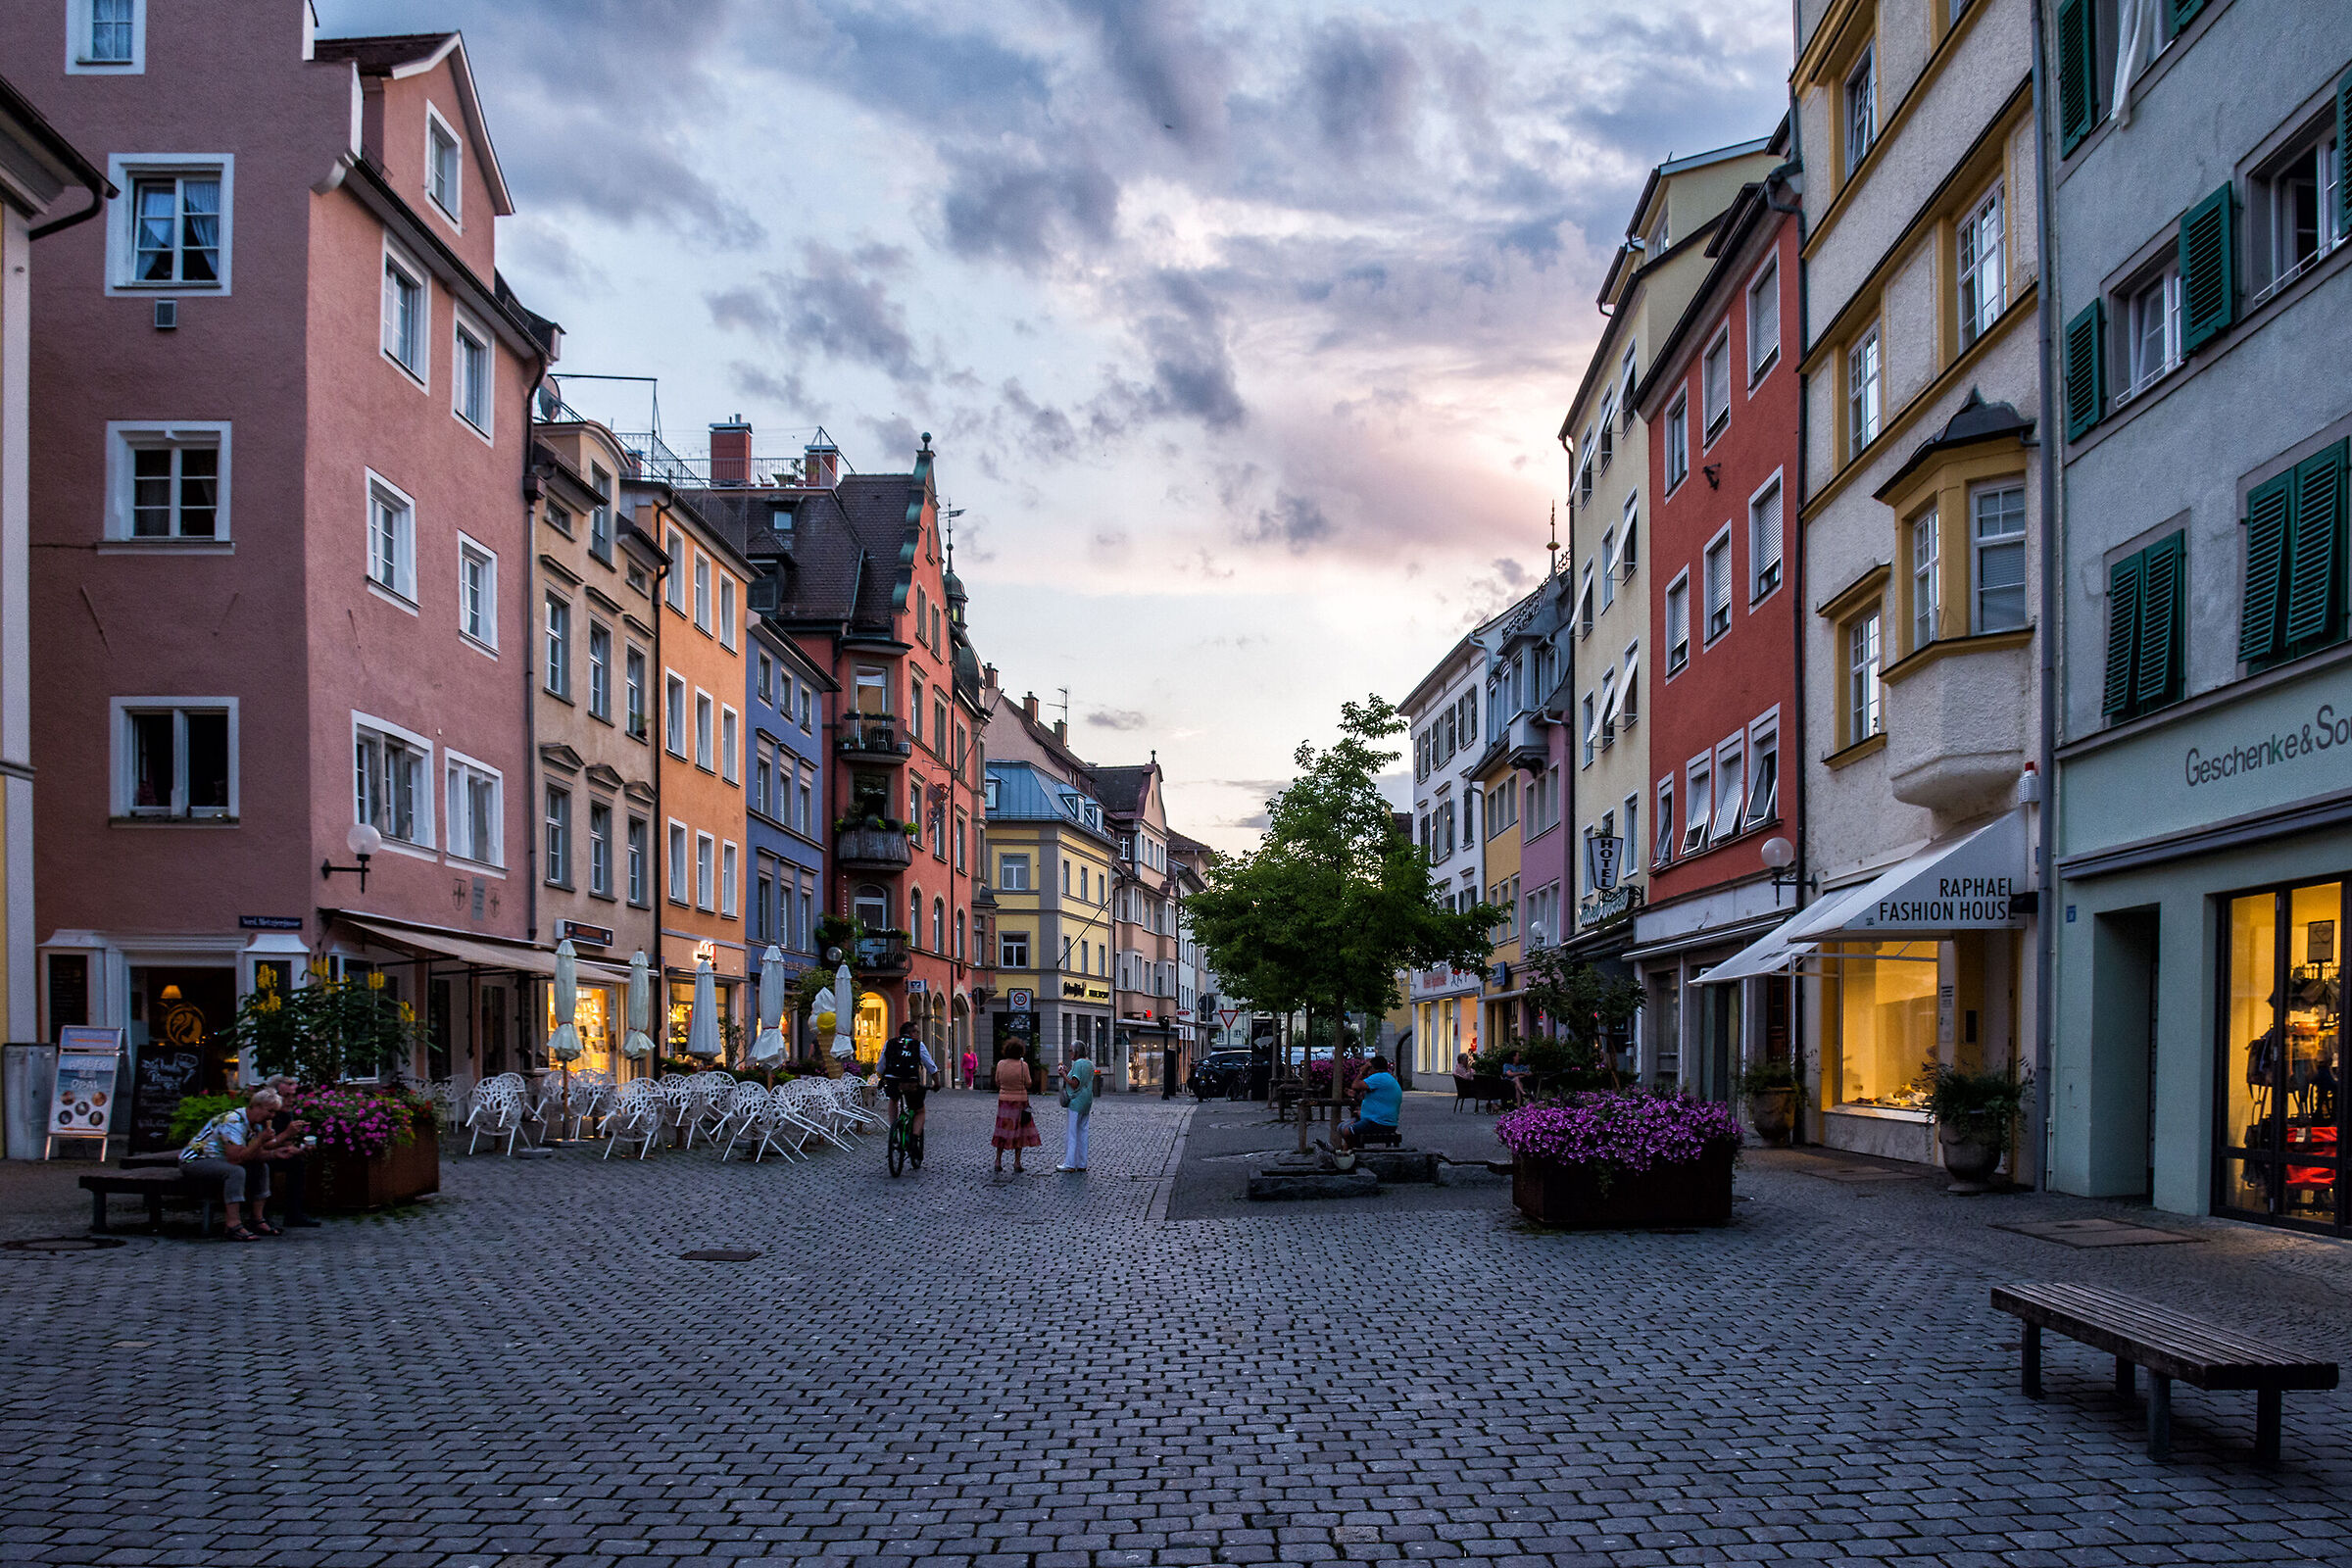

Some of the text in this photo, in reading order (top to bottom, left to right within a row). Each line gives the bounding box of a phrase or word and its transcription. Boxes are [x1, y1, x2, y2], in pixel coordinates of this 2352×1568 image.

[2185, 704, 2352, 787] Geschenke&So
[1599, 839, 1613, 888] HOTEL
[1939, 877, 2013, 898] RAPHAEL
[1879, 901, 1954, 921] FASHION
